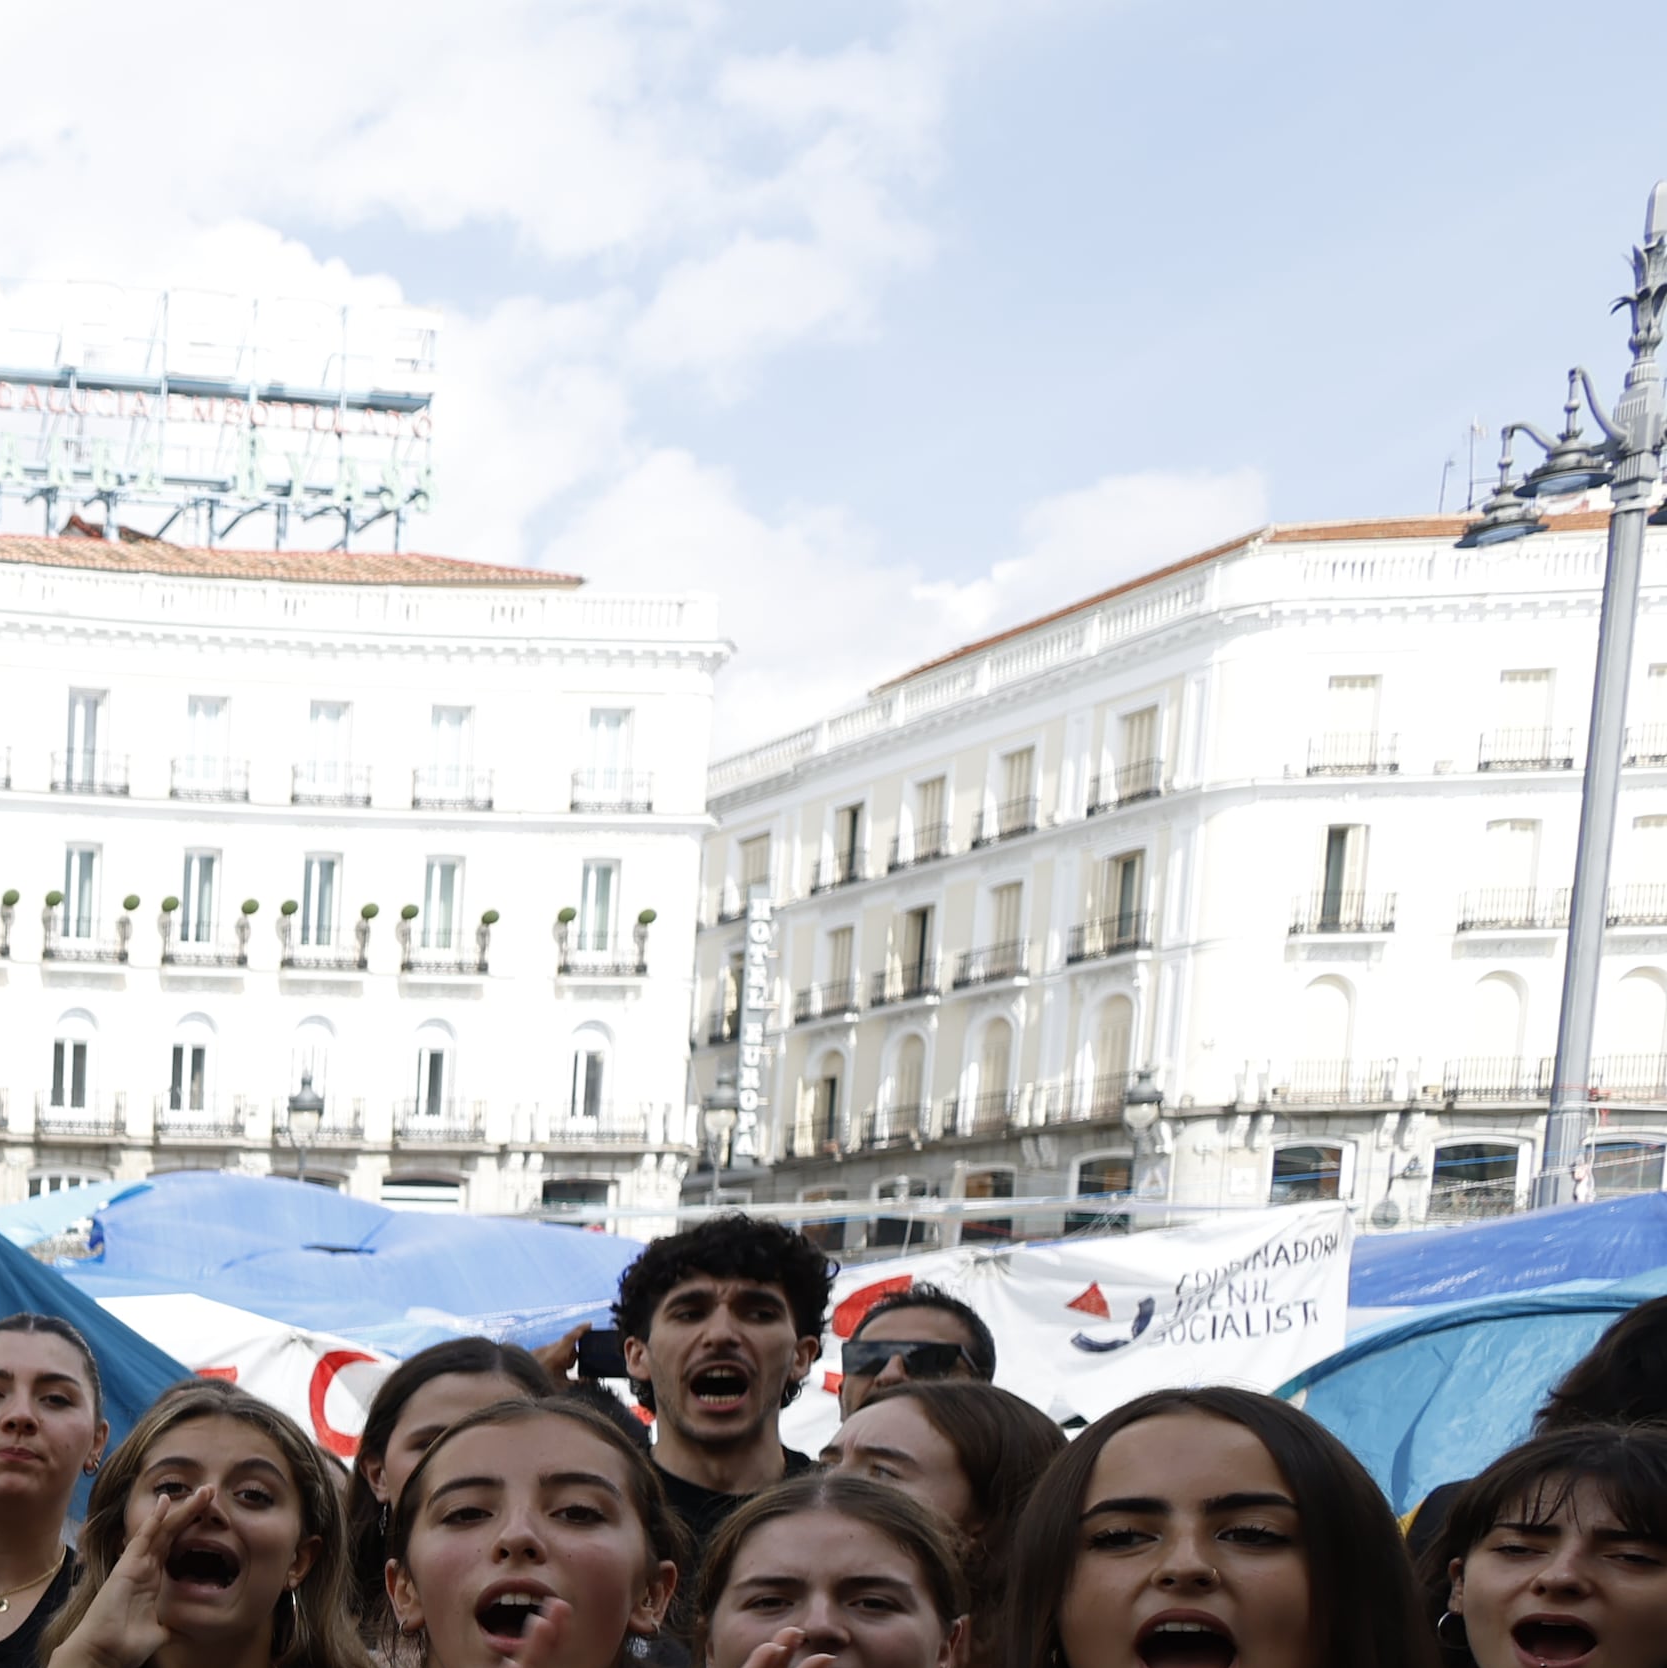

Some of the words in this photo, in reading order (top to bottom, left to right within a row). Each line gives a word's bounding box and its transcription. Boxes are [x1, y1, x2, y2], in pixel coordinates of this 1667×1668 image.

[59, 278, 443, 392] PEPE
[747, 898, 772, 1009] HOTEL
[736, 1022, 763, 1156] EUROPA
